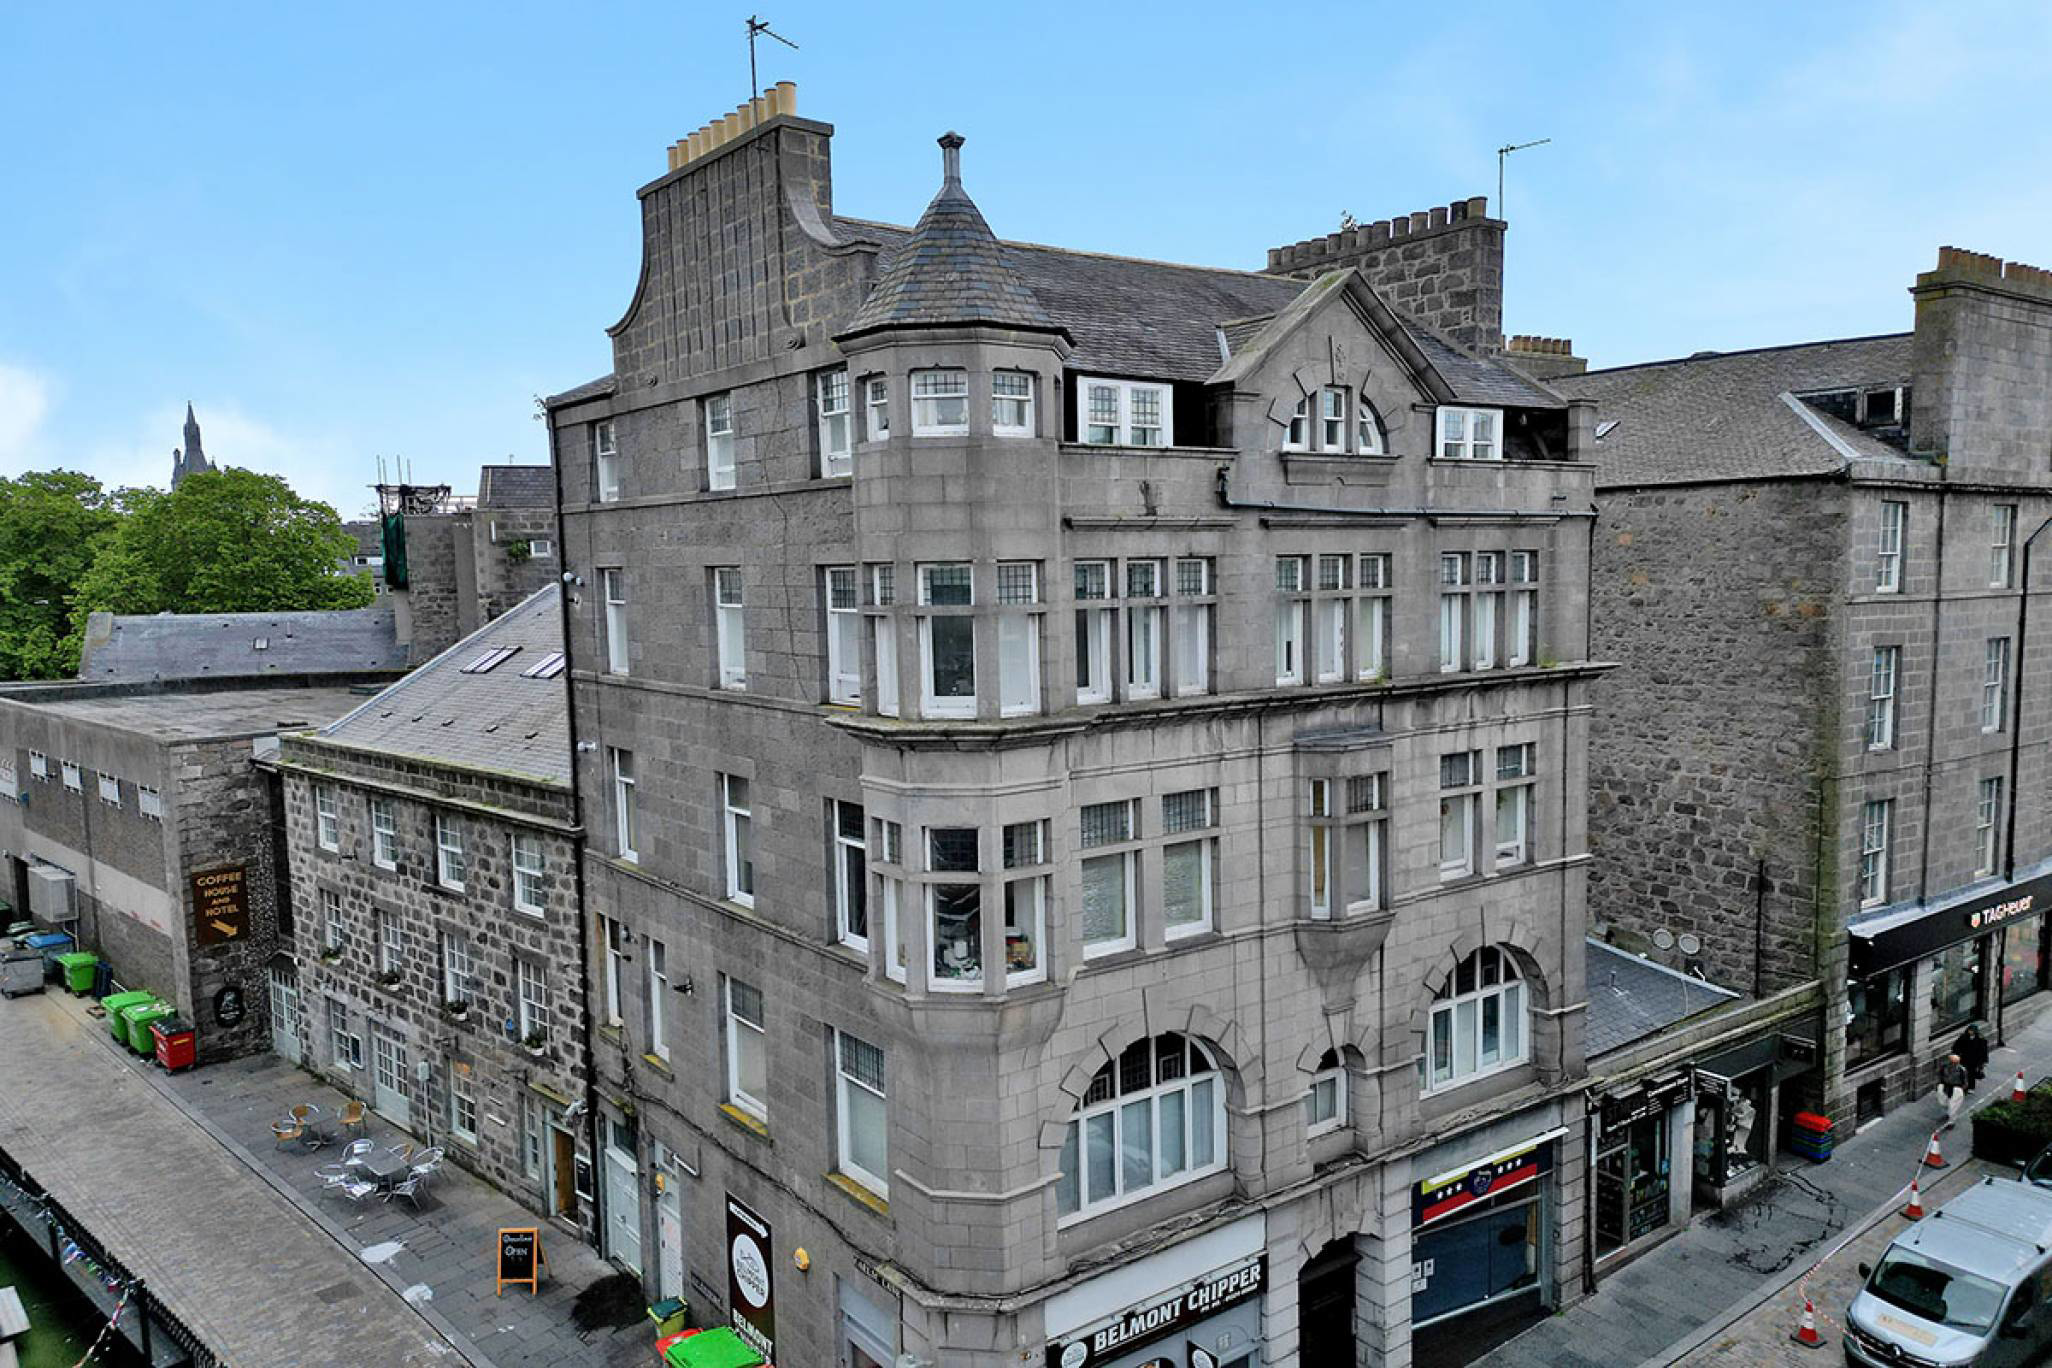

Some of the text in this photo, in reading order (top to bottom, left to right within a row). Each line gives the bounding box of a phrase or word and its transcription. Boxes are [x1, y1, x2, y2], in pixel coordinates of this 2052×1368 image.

[197, 871, 242, 887] COFFEE
[204, 884, 238, 898] HOUSE
[211, 897, 230, 905] AND
[205, 904, 239, 917] HOTEL
[1094, 1298, 1183, 1352] BELMONT
[1187, 1264, 1261, 1311] CHIPPER
